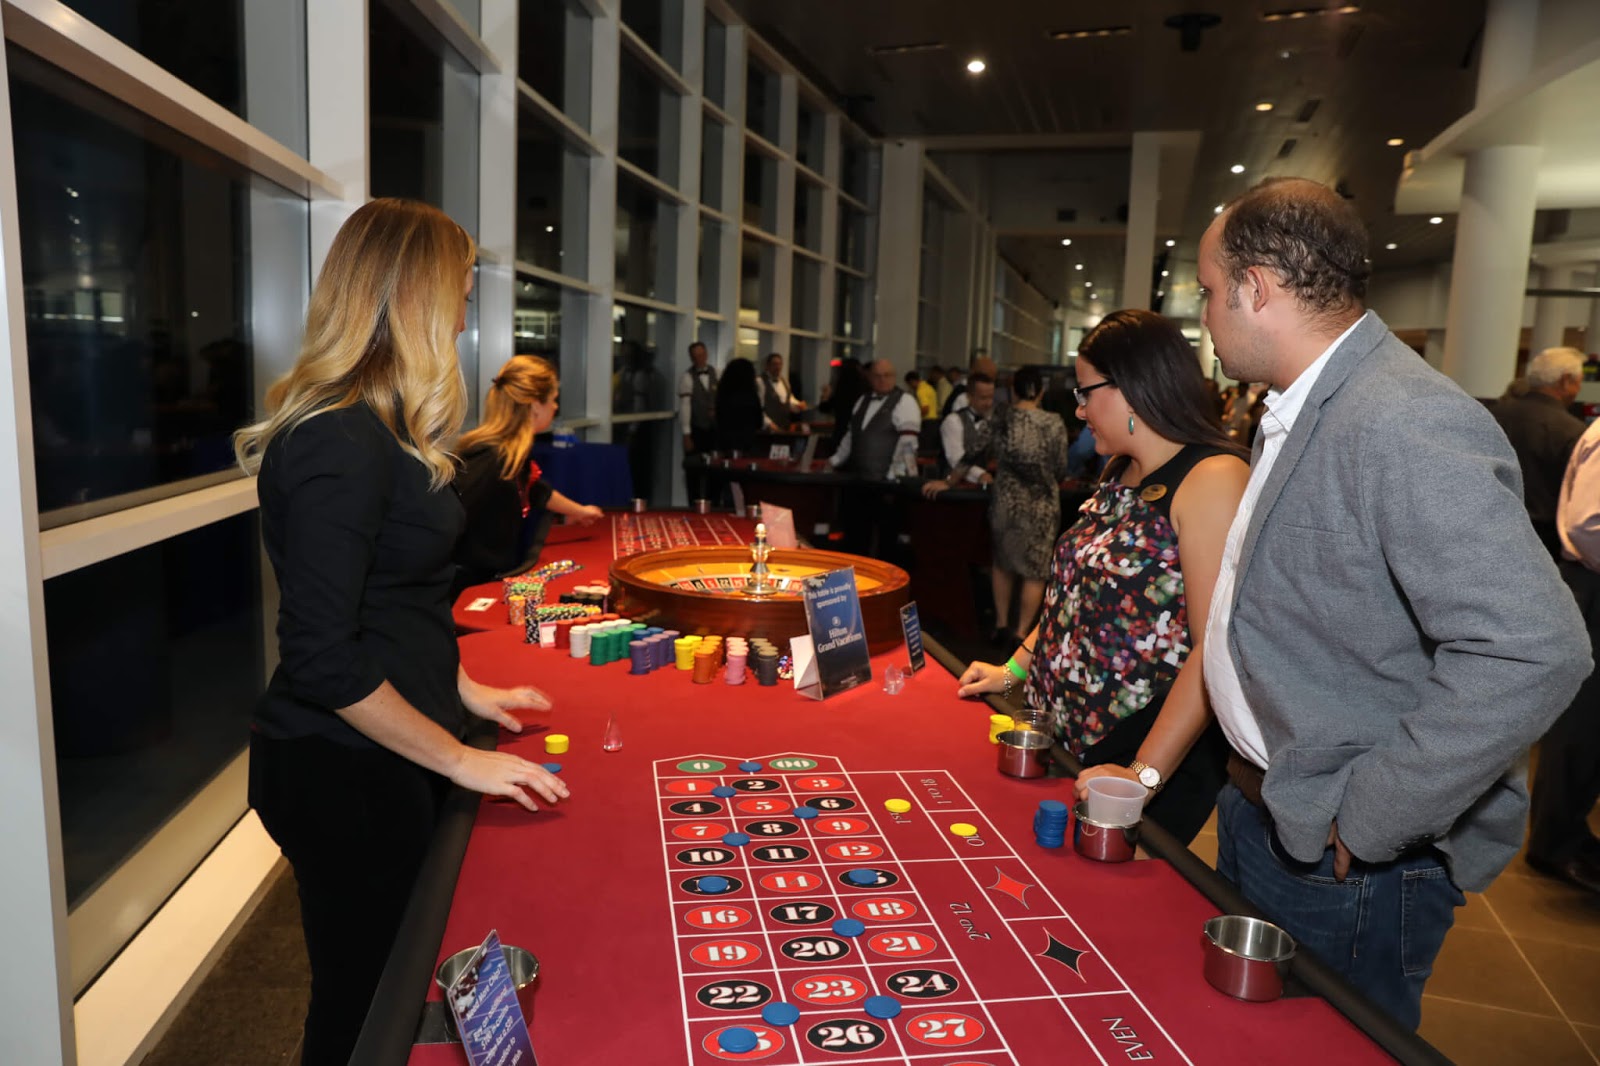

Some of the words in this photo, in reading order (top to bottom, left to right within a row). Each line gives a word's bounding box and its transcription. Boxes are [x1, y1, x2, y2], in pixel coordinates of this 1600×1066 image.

[834, 582, 851, 593] proudly
[816, 596, 840, 609] sponsored
[829, 626, 848, 639] Hilton
[818, 640, 836, 654] Grand
[836, 631, 863, 648] Vacations
[693, 761, 710, 770] 0
[776, 760, 809, 769] 00
[688, 783, 696, 791] 1
[747, 781, 766, 789] 2
[813, 779, 829, 788] 3
[685, 803, 703, 812] 4
[756, 802, 773, 810] 5
[820, 800, 840, 808] 6
[691, 826, 708, 836] 7
[762, 824, 783, 833] 8
[832, 821, 851, 831] 9
[688, 851, 724, 862] 10
[766, 848, 795, 859] 11
[839, 846, 871, 856] 12
[775, 876, 807, 887] 14
[785, 906, 819, 920] 17
[867, 903, 903, 916] 18
[949, 902, 974, 915] 12
[701, 910, 738, 924] 16
[958, 918, 991, 941] 2ND
[792, 940, 839, 957] 20
[883, 936, 921, 951] 21
[707, 945, 746, 961] 19
[805, 981, 853, 998] 23
[897, 974, 950, 993] 24
[709, 986, 761, 1005] 22
[466, 998, 480, 1021] Need
[479, 984, 490, 1002] More
[918, 1018, 965, 1038] 27
[818, 1024, 875, 1047] 26
[1102, 1017, 1154, 1062] EVEN
